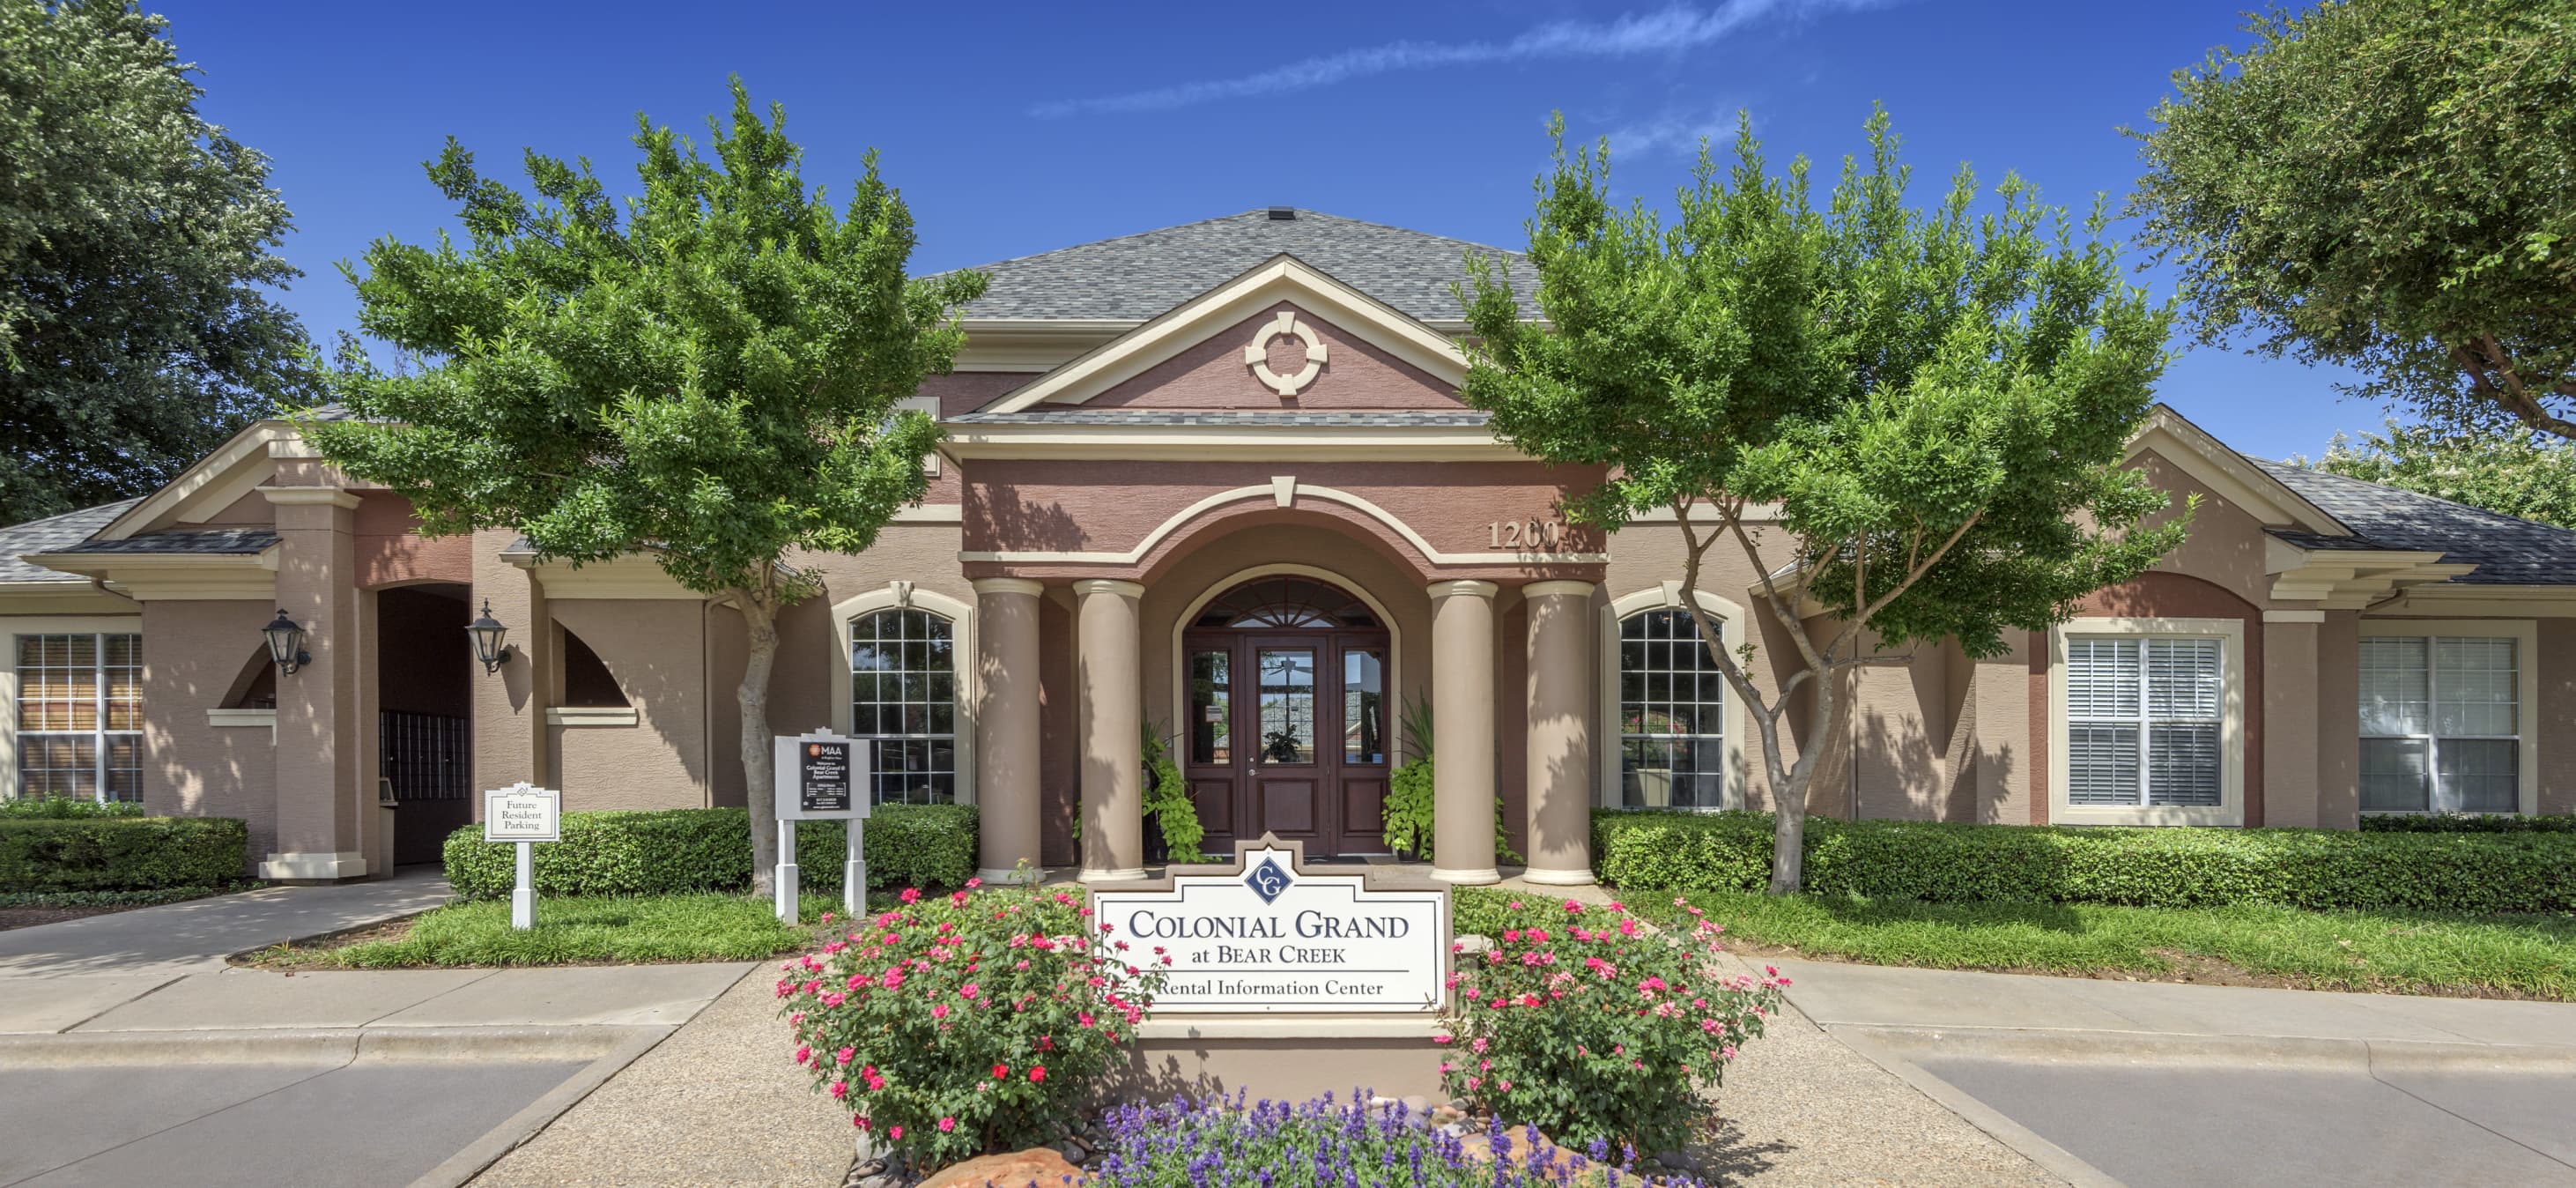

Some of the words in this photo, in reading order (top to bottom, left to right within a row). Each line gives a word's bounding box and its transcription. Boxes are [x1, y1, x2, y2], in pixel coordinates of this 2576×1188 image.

[1487, 521, 1559, 549] 1200
[821, 746, 842, 755] MAA
[507, 800, 537, 809] Future
[501, 810, 542, 820] Resident
[505, 820, 540, 831] Parking
[1129, 910, 1287, 939] COLONIAL
[1295, 910, 1410, 939] GRAND
[1191, 948, 1210, 964] at
[1217, 945, 1272, 964] BEAR
[1278, 945, 1347, 964] CREEK
[1157, 979, 1212, 996] Rental
[1217, 979, 1320, 996] Information
[1325, 979, 1384, 996] Center
